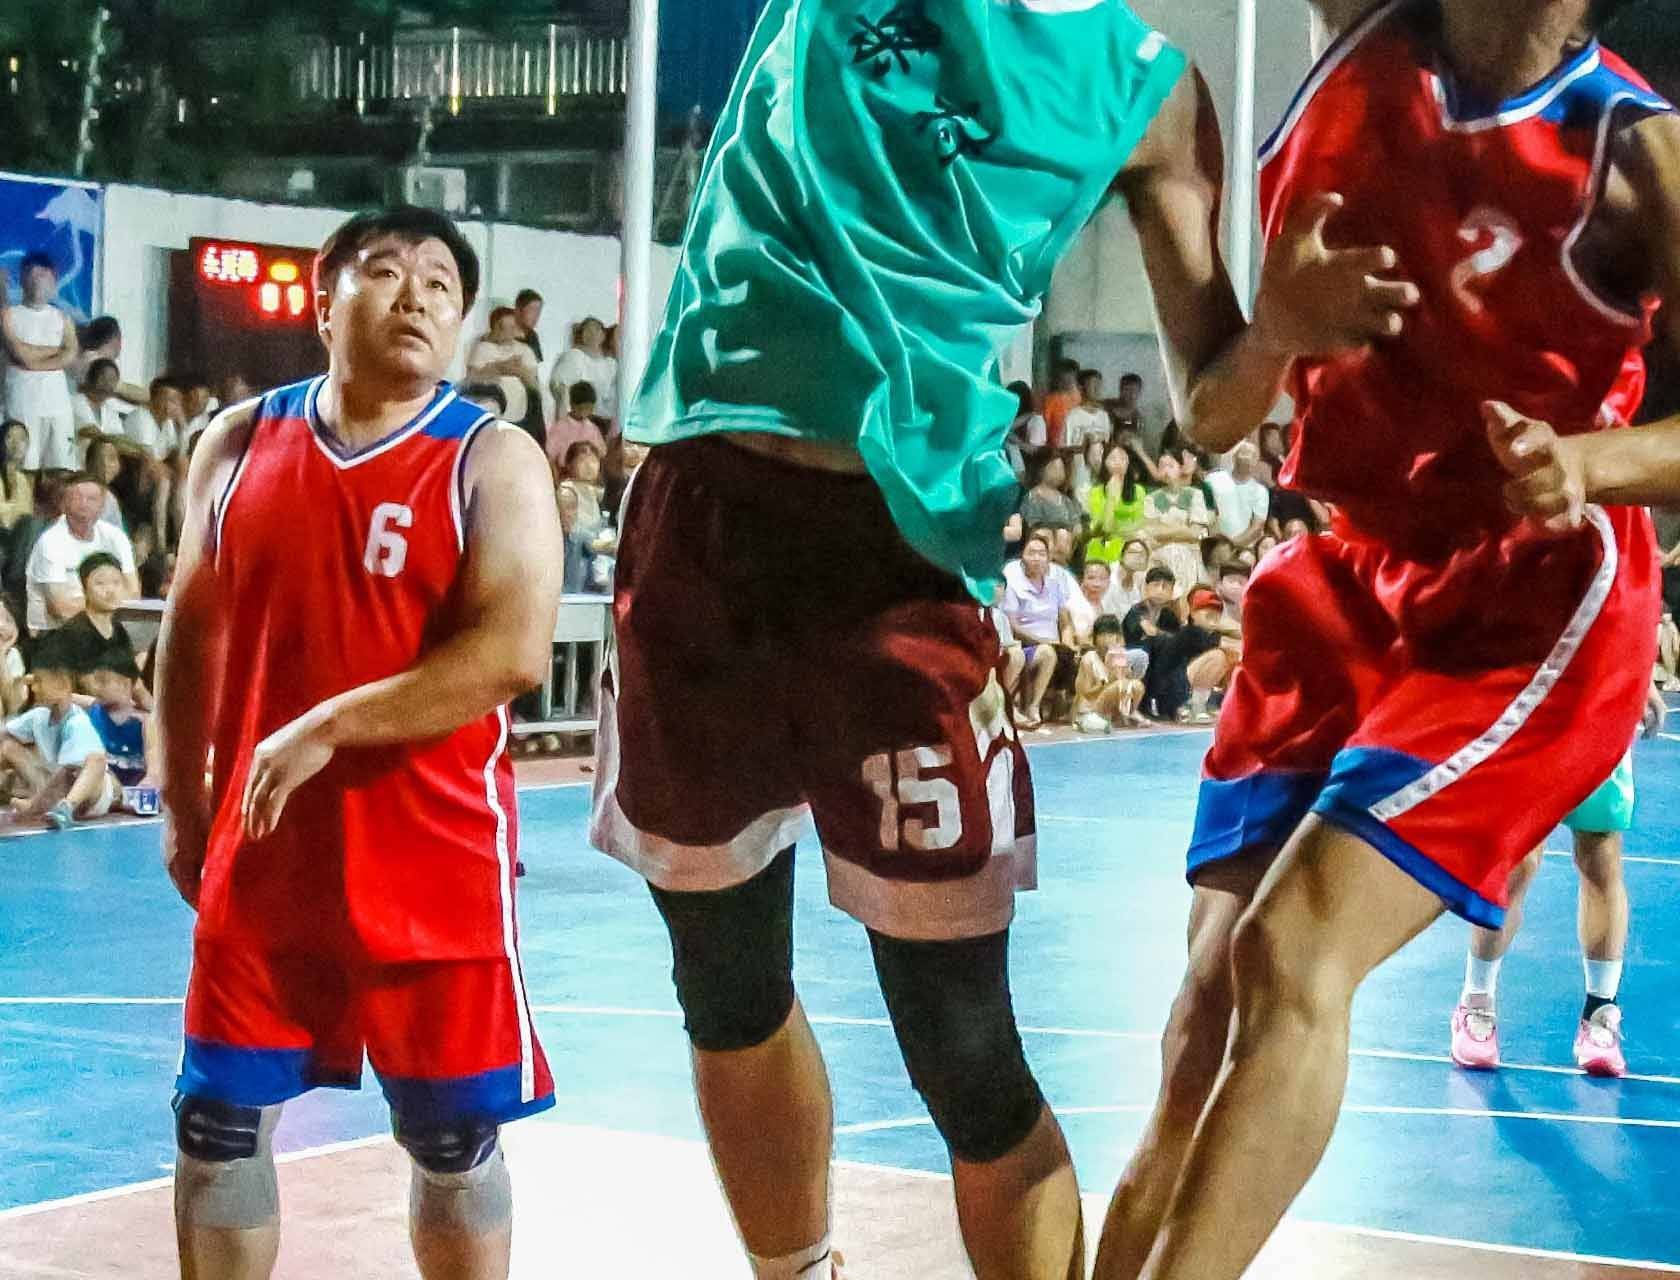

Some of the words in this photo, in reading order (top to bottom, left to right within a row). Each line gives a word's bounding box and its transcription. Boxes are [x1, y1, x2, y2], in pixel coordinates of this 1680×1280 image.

[1450, 206, 1524, 315] 2
[363, 501, 413, 578] 6
[861, 745, 963, 851] 15
